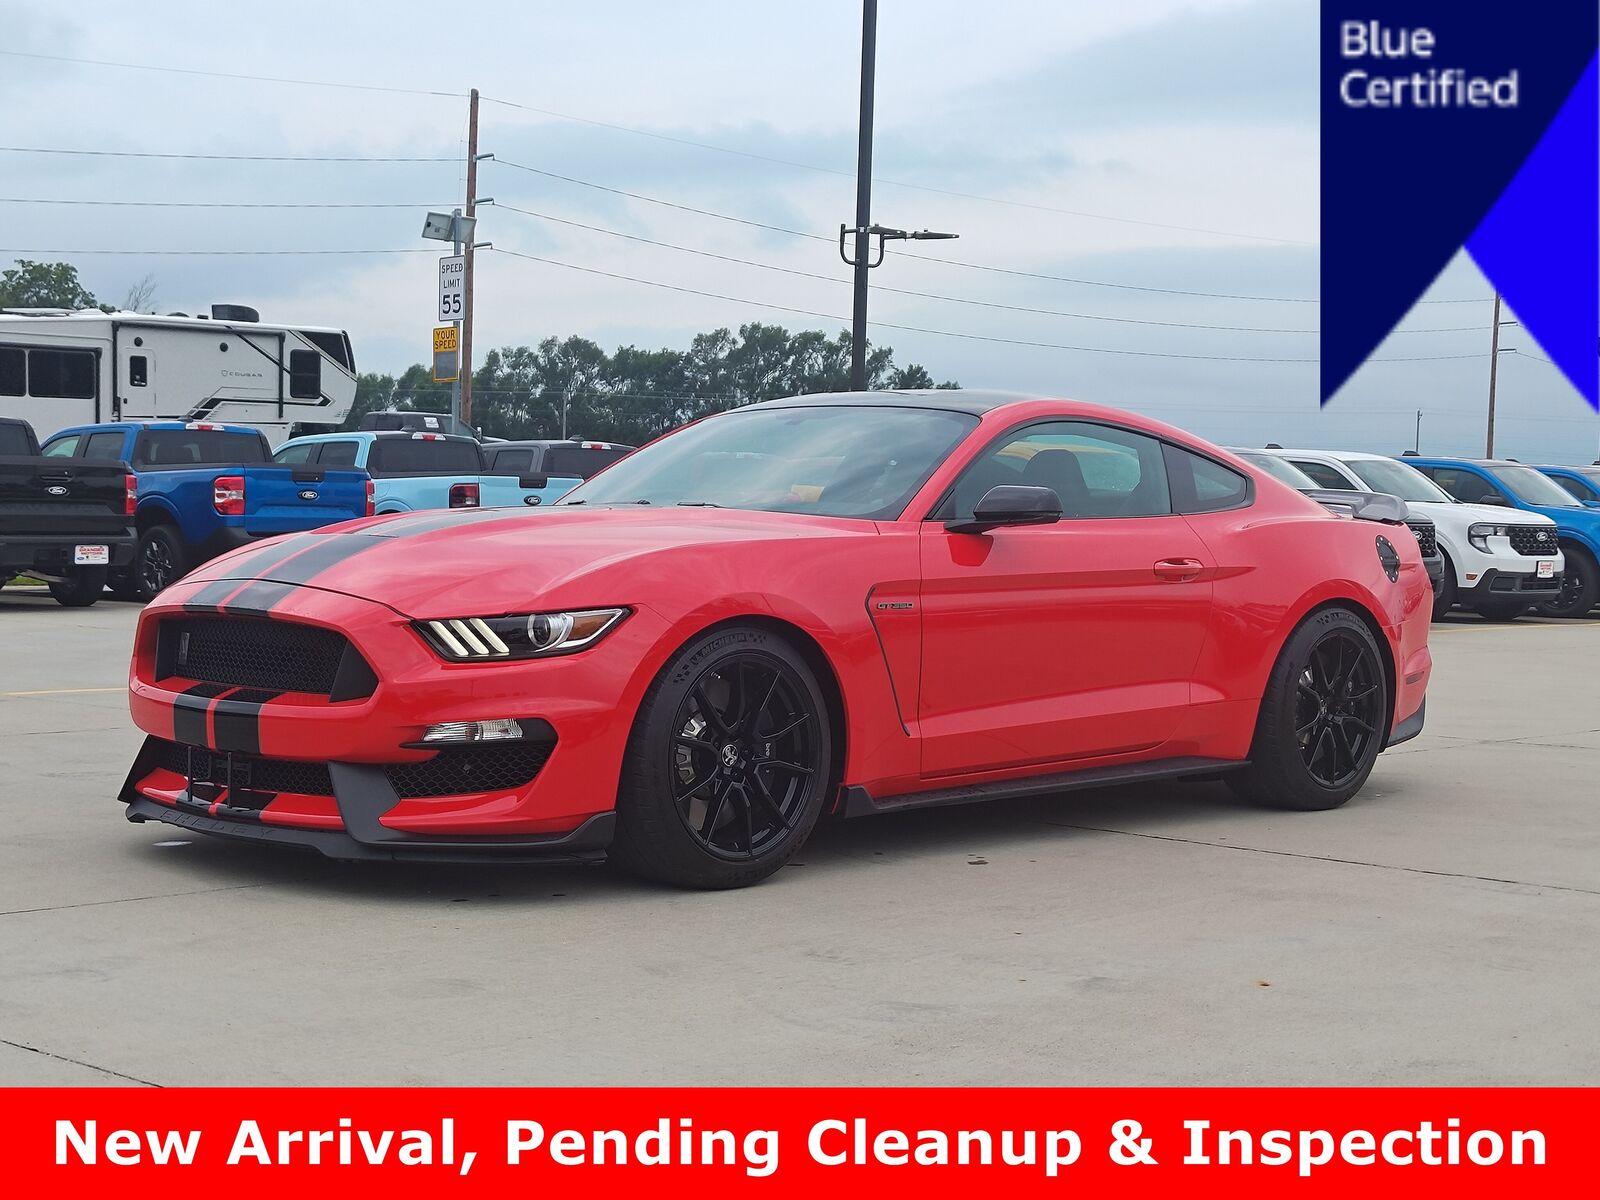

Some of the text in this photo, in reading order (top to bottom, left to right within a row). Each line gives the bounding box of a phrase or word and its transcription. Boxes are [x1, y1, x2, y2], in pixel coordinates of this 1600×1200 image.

[441, 263, 463, 274] SPEED
[443, 279, 460, 289] LIMIT
[442, 294, 461, 314] 55
[436, 330, 455, 340] YOUR
[435, 339, 457, 350] SPEED
